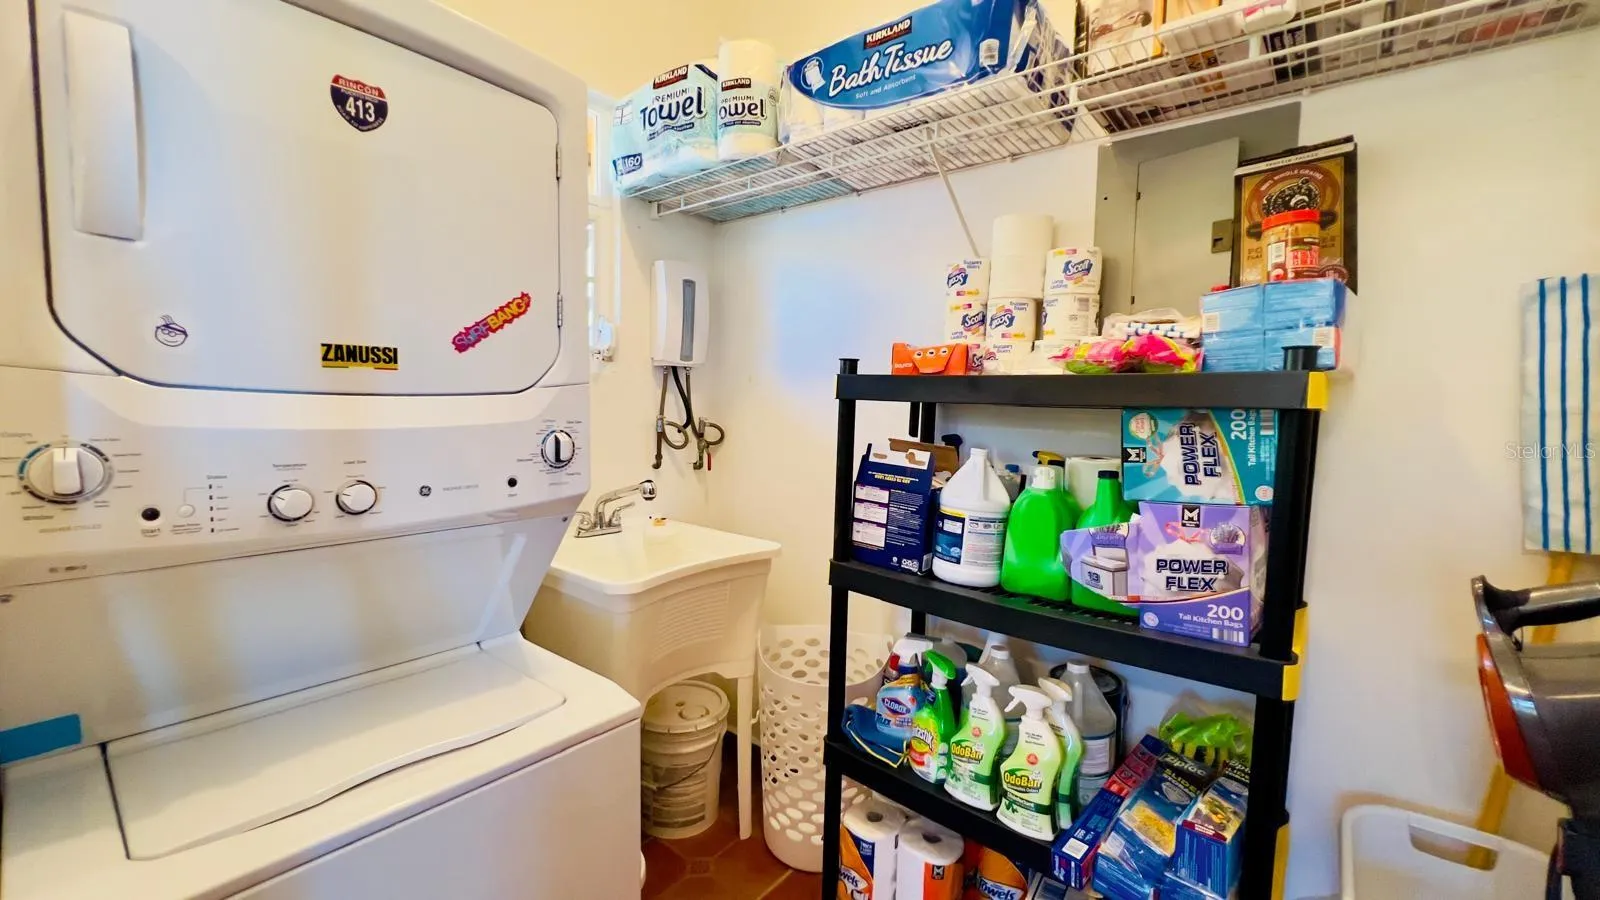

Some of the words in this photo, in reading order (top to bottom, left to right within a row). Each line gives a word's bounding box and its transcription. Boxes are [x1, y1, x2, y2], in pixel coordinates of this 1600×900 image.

[866, 19, 911, 43] KIRKLAND
[655, 66, 688, 84] KIRKLAND
[829, 54, 883, 97] Bath
[882, 40, 953, 77] Tissue
[338, 78, 379, 96] RINCON
[722, 79, 750, 88] KIRKLAND
[855, 90, 869, 99] Soft
[870, 86, 882, 96] and
[346, 97, 375, 122] 413
[640, 87, 704, 131] Towel
[718, 99, 765, 119] owel
[624, 155, 641, 167] 160
[321, 343, 398, 364] ZANUSSI
[1231, 408, 1247, 440] 200
[1248, 427, 1256, 454] Kitchen
[1179, 423, 1202, 485] POWER
[1201, 432, 1222, 477] FLEX
[1248, 454, 1256, 467] Tall
[1156, 559, 1229, 575] POWER
[1087, 571, 1100, 583] 13
[1165, 576, 1216, 592] FLEX
[1179, 612, 1192, 621] Tall
[1193, 615, 1222, 625] Kitchen
[1223, 620, 1244, 629] Bags
[1207, 604, 1244, 621] 200
[884, 698, 907, 713] CLOROX
[951, 743, 983, 761] OdoBan
[1163, 754, 1206, 776] Ziploc
[1004, 771, 1042, 789] OdoBan
